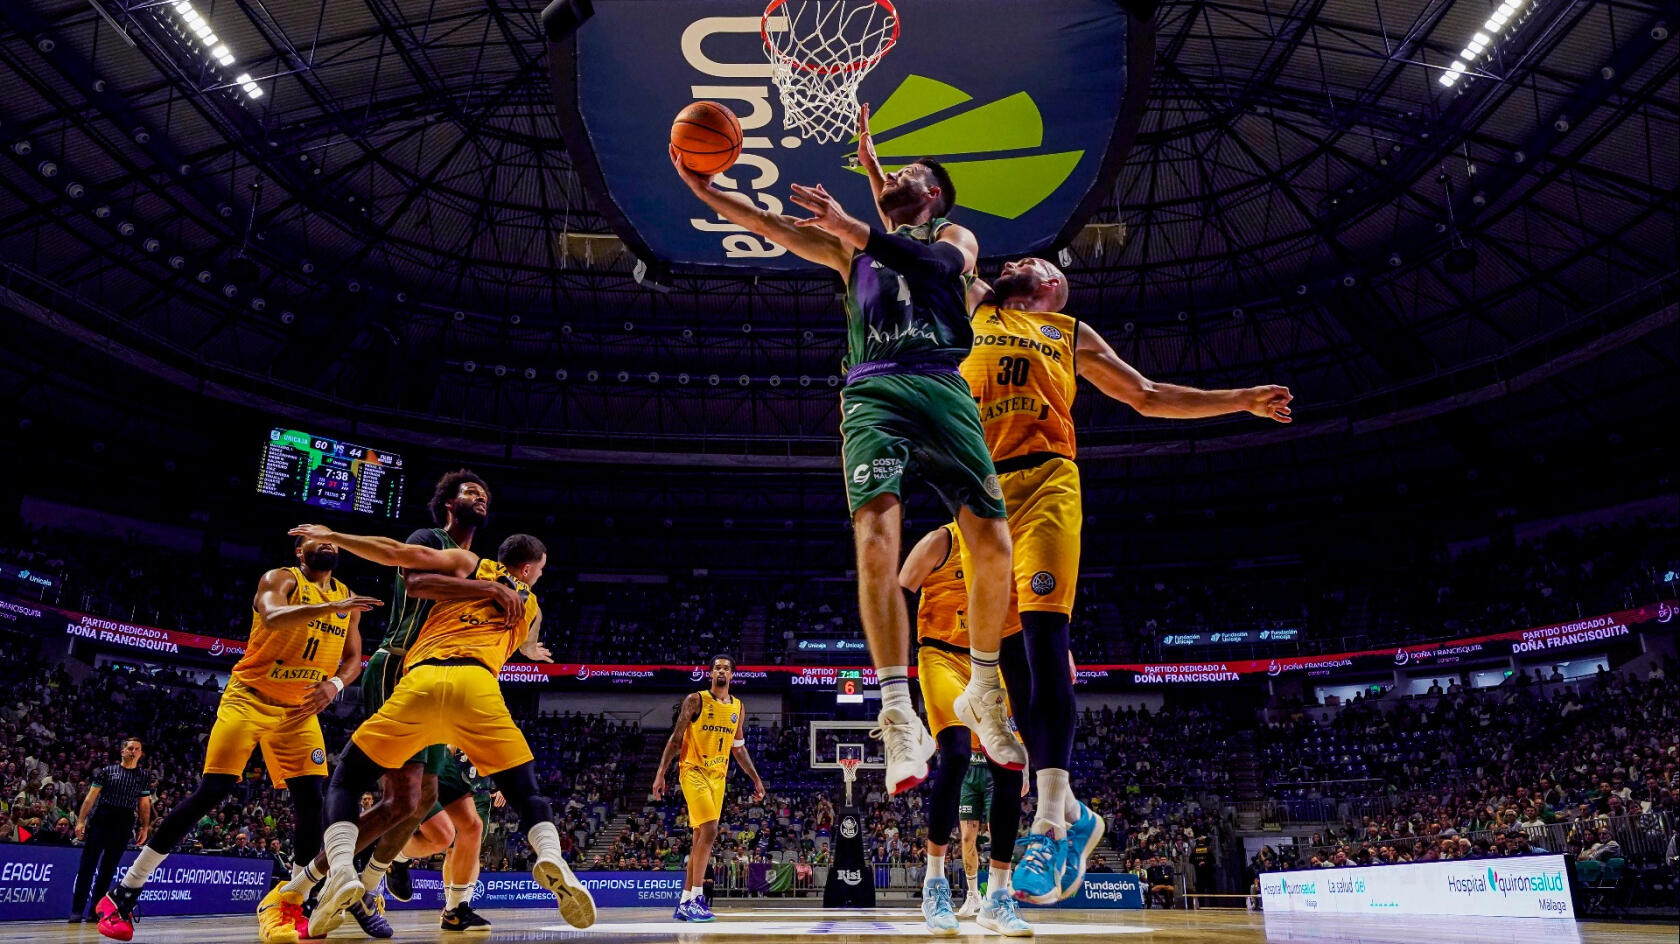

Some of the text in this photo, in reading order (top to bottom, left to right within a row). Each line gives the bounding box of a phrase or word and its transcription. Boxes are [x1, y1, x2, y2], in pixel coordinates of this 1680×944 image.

[681, 16, 802, 258] Unicaja
[973, 334, 1062, 362] OOSTENDE
[997, 356, 1031, 387] 30
[315, 440, 328, 450] 60
[333, 444, 345, 454] VS
[349, 448, 363, 458] 44
[872, 458, 902, 466] COSTA
[325, 468, 349, 481] 7:38
[340, 493, 346, 501] 3
[0, 601, 41, 618] RANCISQUITA
[81, 616, 168, 640] PARTIDO DEDICADO A
[308, 619, 346, 638] STENDE
[1522, 617, 1614, 641] PARTIDO DEDICADO A
[66, 623, 179, 654] DOÑA FRANCISQUITA
[1513, 624, 1629, 654] DOÑA FRANCISQUITA
[302, 637, 320, 661] 11
[500, 665, 532, 673] DICADO
[1144, 665, 1175, 674] PARTIDO
[1176, 665, 1217, 673] DEDICADO
[1283, 659, 1352, 671] DOÑA FRANCISQUITA
[498, 673, 549, 683] NCISQUITA
[611, 670, 654, 678] FRANCISQUITA
[733, 671, 768, 679] ANCISQUITA
[802, 668, 834, 676] PARTIDO
[1134, 671, 1239, 684] DOÑA FRANCISQUITA
[791, 675, 819, 685] DOÑA
[844, 681, 855, 695] 6
[702, 725, 733, 734] OOSTEN
[718, 737, 723, 752] 1
[2, 862, 53, 881] EAGUE
[175, 868, 231, 885] CHAMPIONS
[232, 871, 265, 885] LEAGUE
[837, 869, 862, 885] Risi
[487, 880, 682, 890] BASKETB AMPIONS LEAGUE
[1084, 881, 1135, 890] Fundación
[1336, 875, 1353, 893] salud
[1355, 877, 1365, 892] del
[1448, 872, 1563, 894] Hospital quirónsalud
[0, 888, 48, 902] EASON X
[139, 889, 191, 900] ERESCO SUNEL
[231, 889, 262, 900] SEASON X
[638, 891, 681, 900] SEASON X
[1086, 890, 1123, 901] Unicaja
[1539, 899, 1566, 913] Málaga
